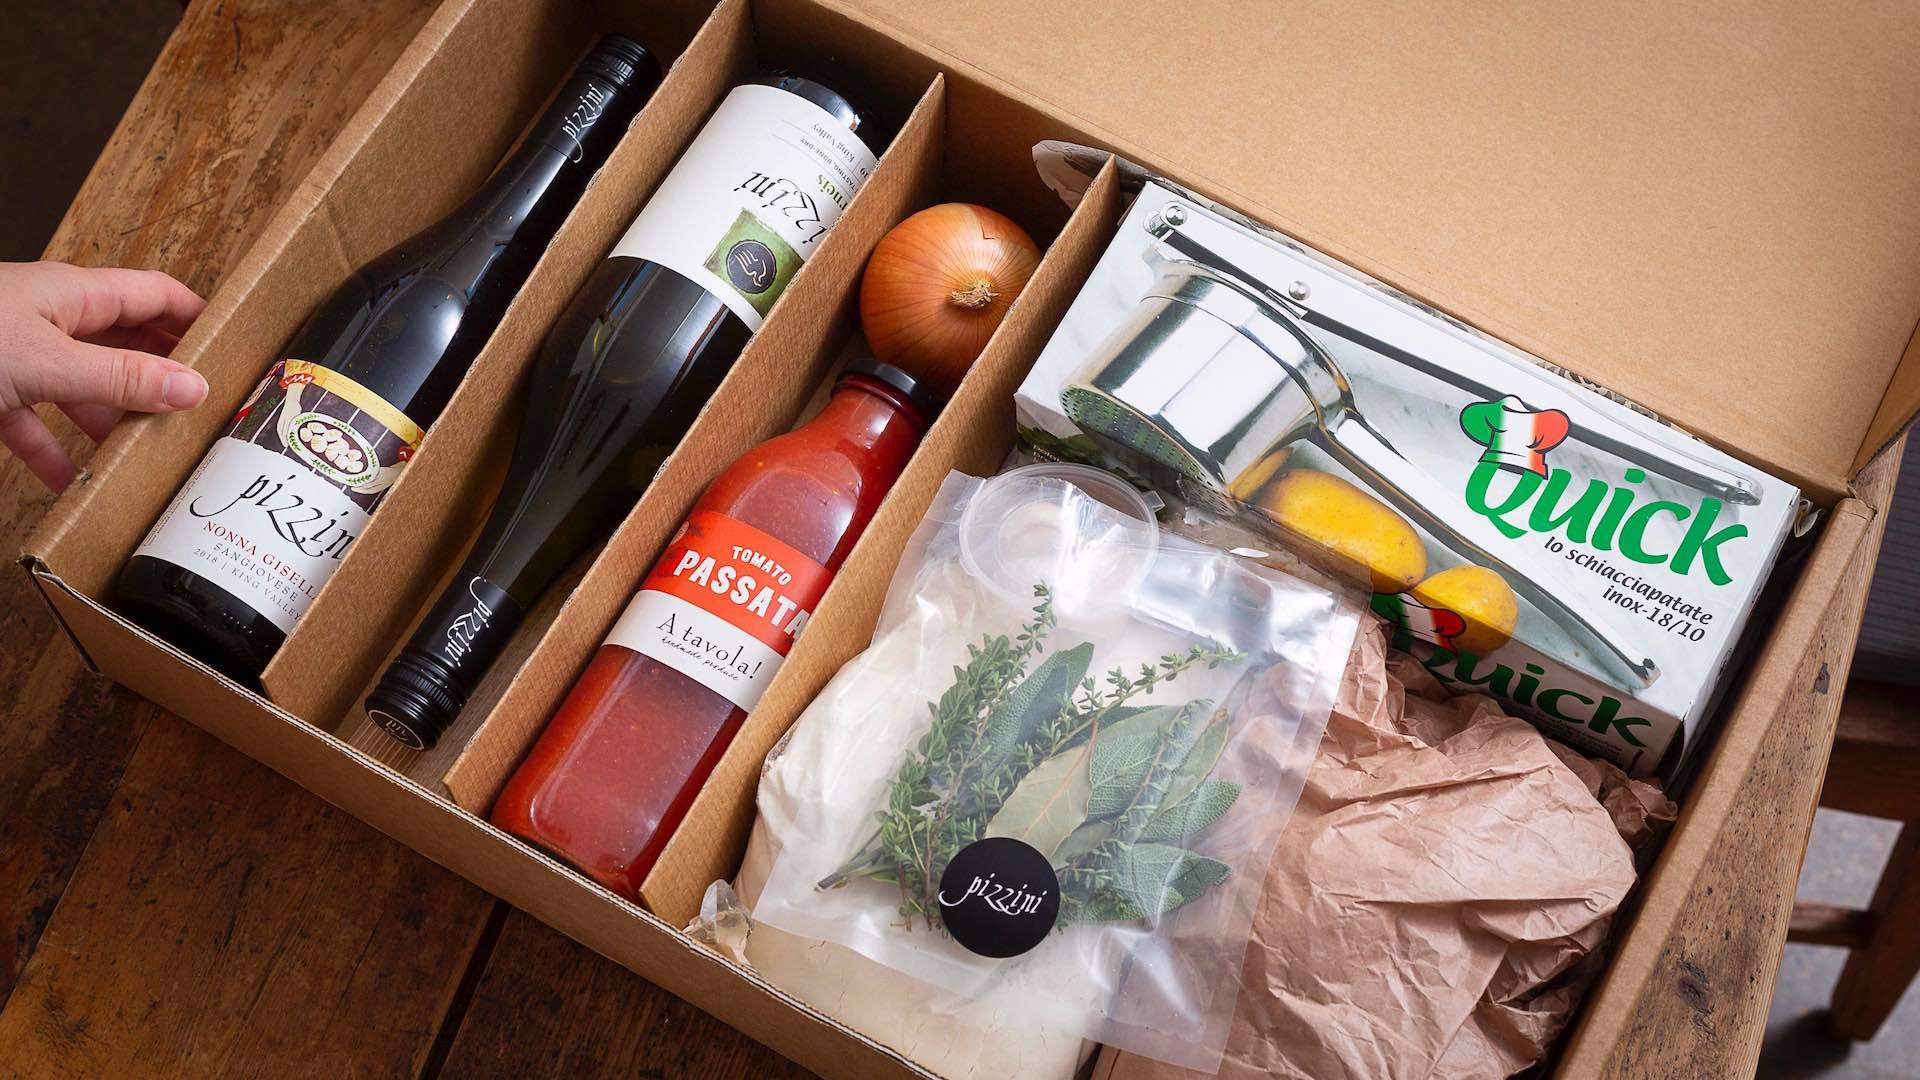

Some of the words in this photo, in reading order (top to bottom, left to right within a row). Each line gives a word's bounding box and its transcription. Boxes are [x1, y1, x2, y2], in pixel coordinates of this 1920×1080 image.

[562, 83, 605, 164] pizzini
[837, 141, 856, 162] King
[733, 171, 828, 244] izzini
[816, 174, 848, 211] rneis
[190, 474, 355, 560] pizzin
[1464, 461, 1748, 586] Quick
[193, 548, 218, 564] 2018
[231, 567, 260, 589] KING
[264, 588, 302, 620] VALLEY
[203, 520, 257, 556] NONNA
[262, 553, 316, 600] GISELL
[213, 542, 299, 602] SANGIOVESE
[672, 549, 810, 641] PASSATA
[732, 545, 792, 585] TOMATO
[1544, 536, 1564, 553] lo
[1565, 549, 1713, 625] schiacciapatate
[444, 576, 493, 667] pizzini
[656, 613, 676, 636] A
[682, 626, 762, 679] tavola!
[1602, 585, 1705, 642] inox-18/10
[703, 659, 739, 680] produce
[938, 873, 1048, 916] pizzini
